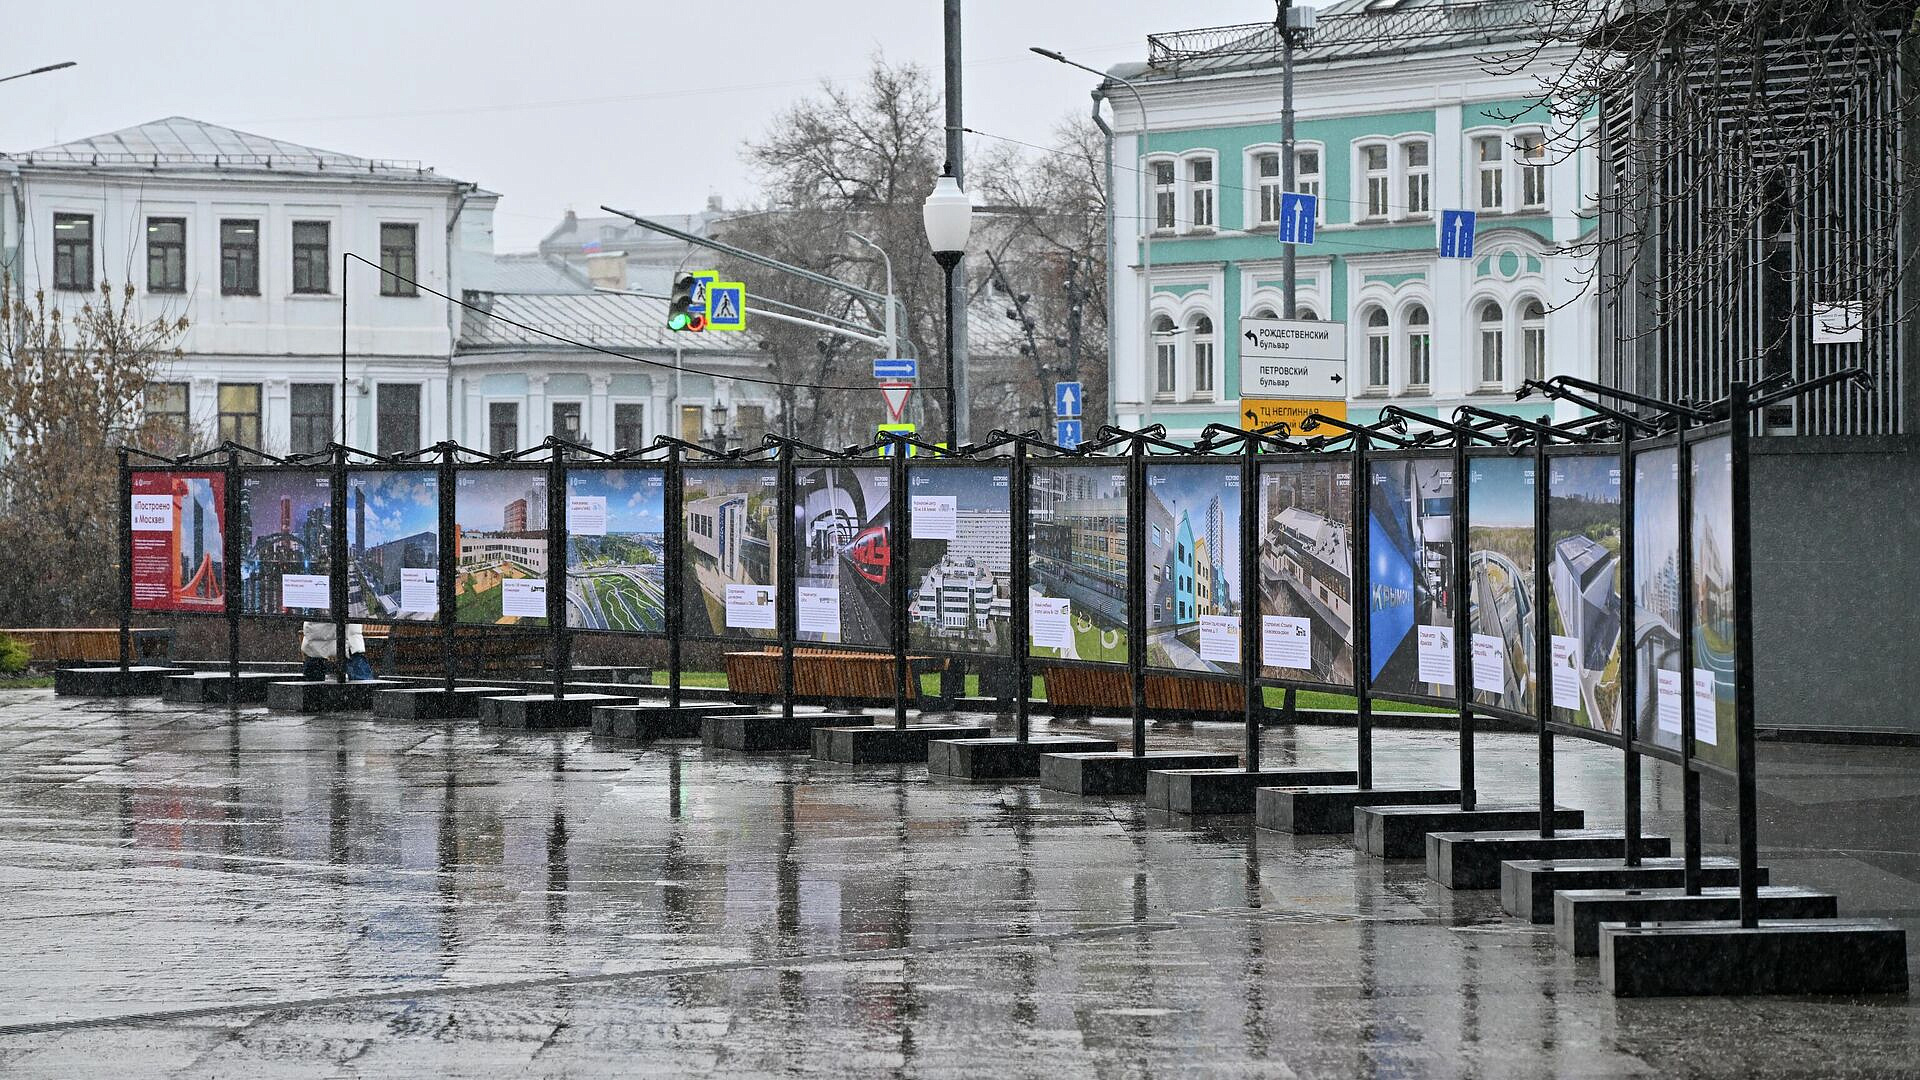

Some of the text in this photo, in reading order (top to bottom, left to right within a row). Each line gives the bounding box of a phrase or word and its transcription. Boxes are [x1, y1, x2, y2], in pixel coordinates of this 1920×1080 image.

[1260, 328, 1329, 340] РОЖДЕСТВЕНСКИЙ
[1260, 340, 1290, 350] бульвар
[1260, 365, 1309, 376] ПЕТРОВСКИЙ
[1260, 377, 1290, 387] бульвар
[1260, 407, 1320, 417] ТЦ НЕГЛИННАЯ
